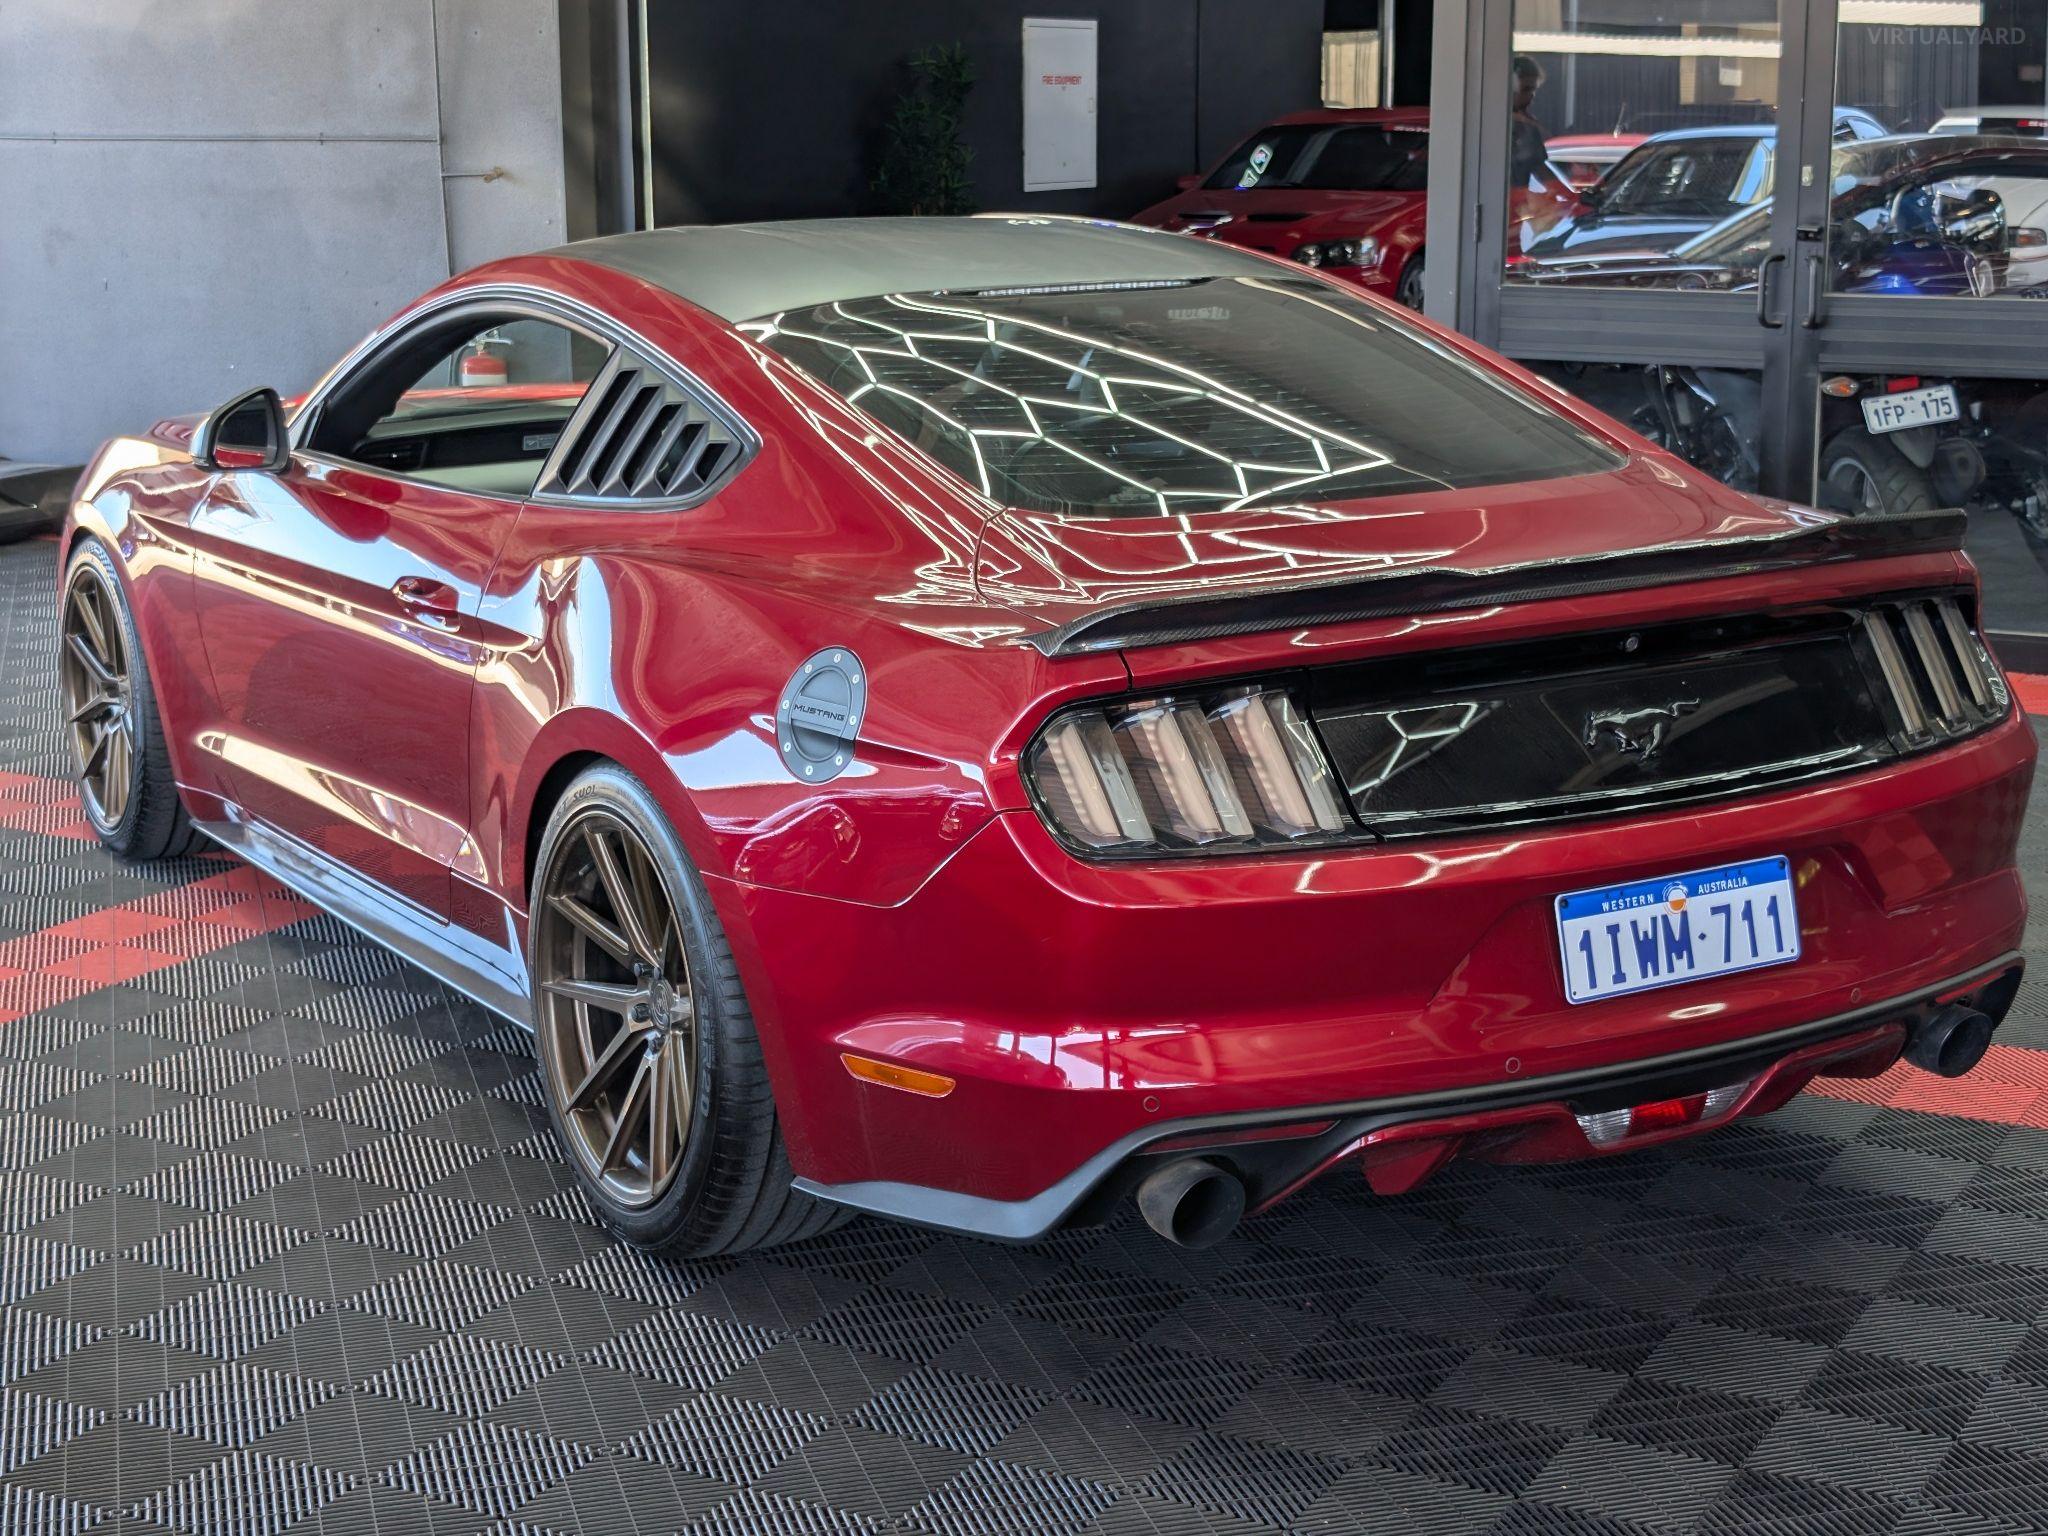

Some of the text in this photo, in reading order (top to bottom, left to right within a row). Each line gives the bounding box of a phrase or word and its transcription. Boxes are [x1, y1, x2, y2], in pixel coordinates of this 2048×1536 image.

[793, 704, 845, 721] MUSTANG
[1602, 876, 1748, 912] WESTERN AUSTRALIA
